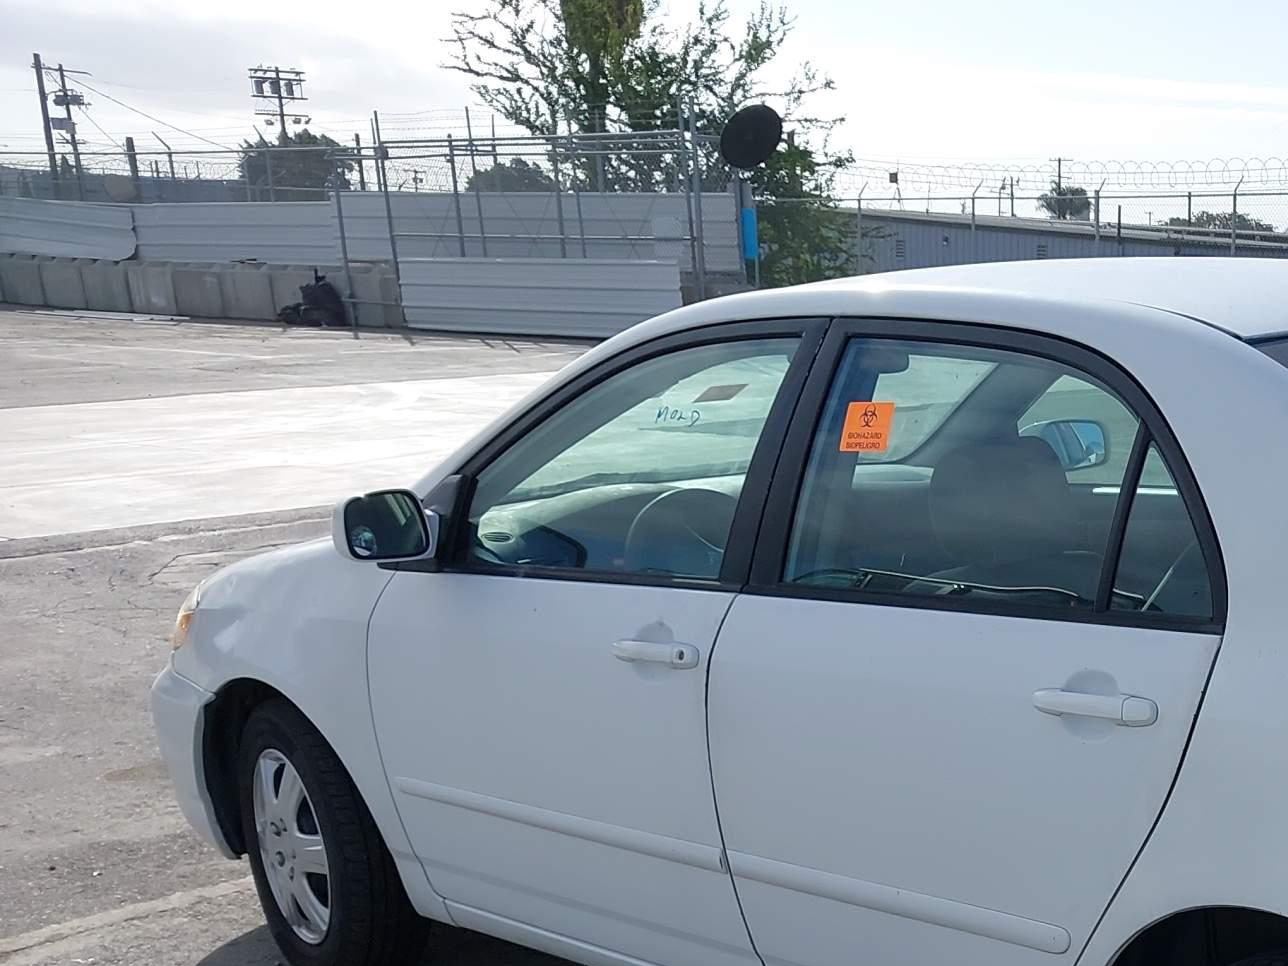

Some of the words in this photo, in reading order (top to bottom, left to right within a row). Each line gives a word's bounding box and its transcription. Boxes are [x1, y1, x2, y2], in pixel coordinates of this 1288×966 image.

[655, 406, 701, 428] MOLD
[847, 431, 882, 440] BIOHAZARD
[845, 441, 881, 450] BIOPELIGRO
